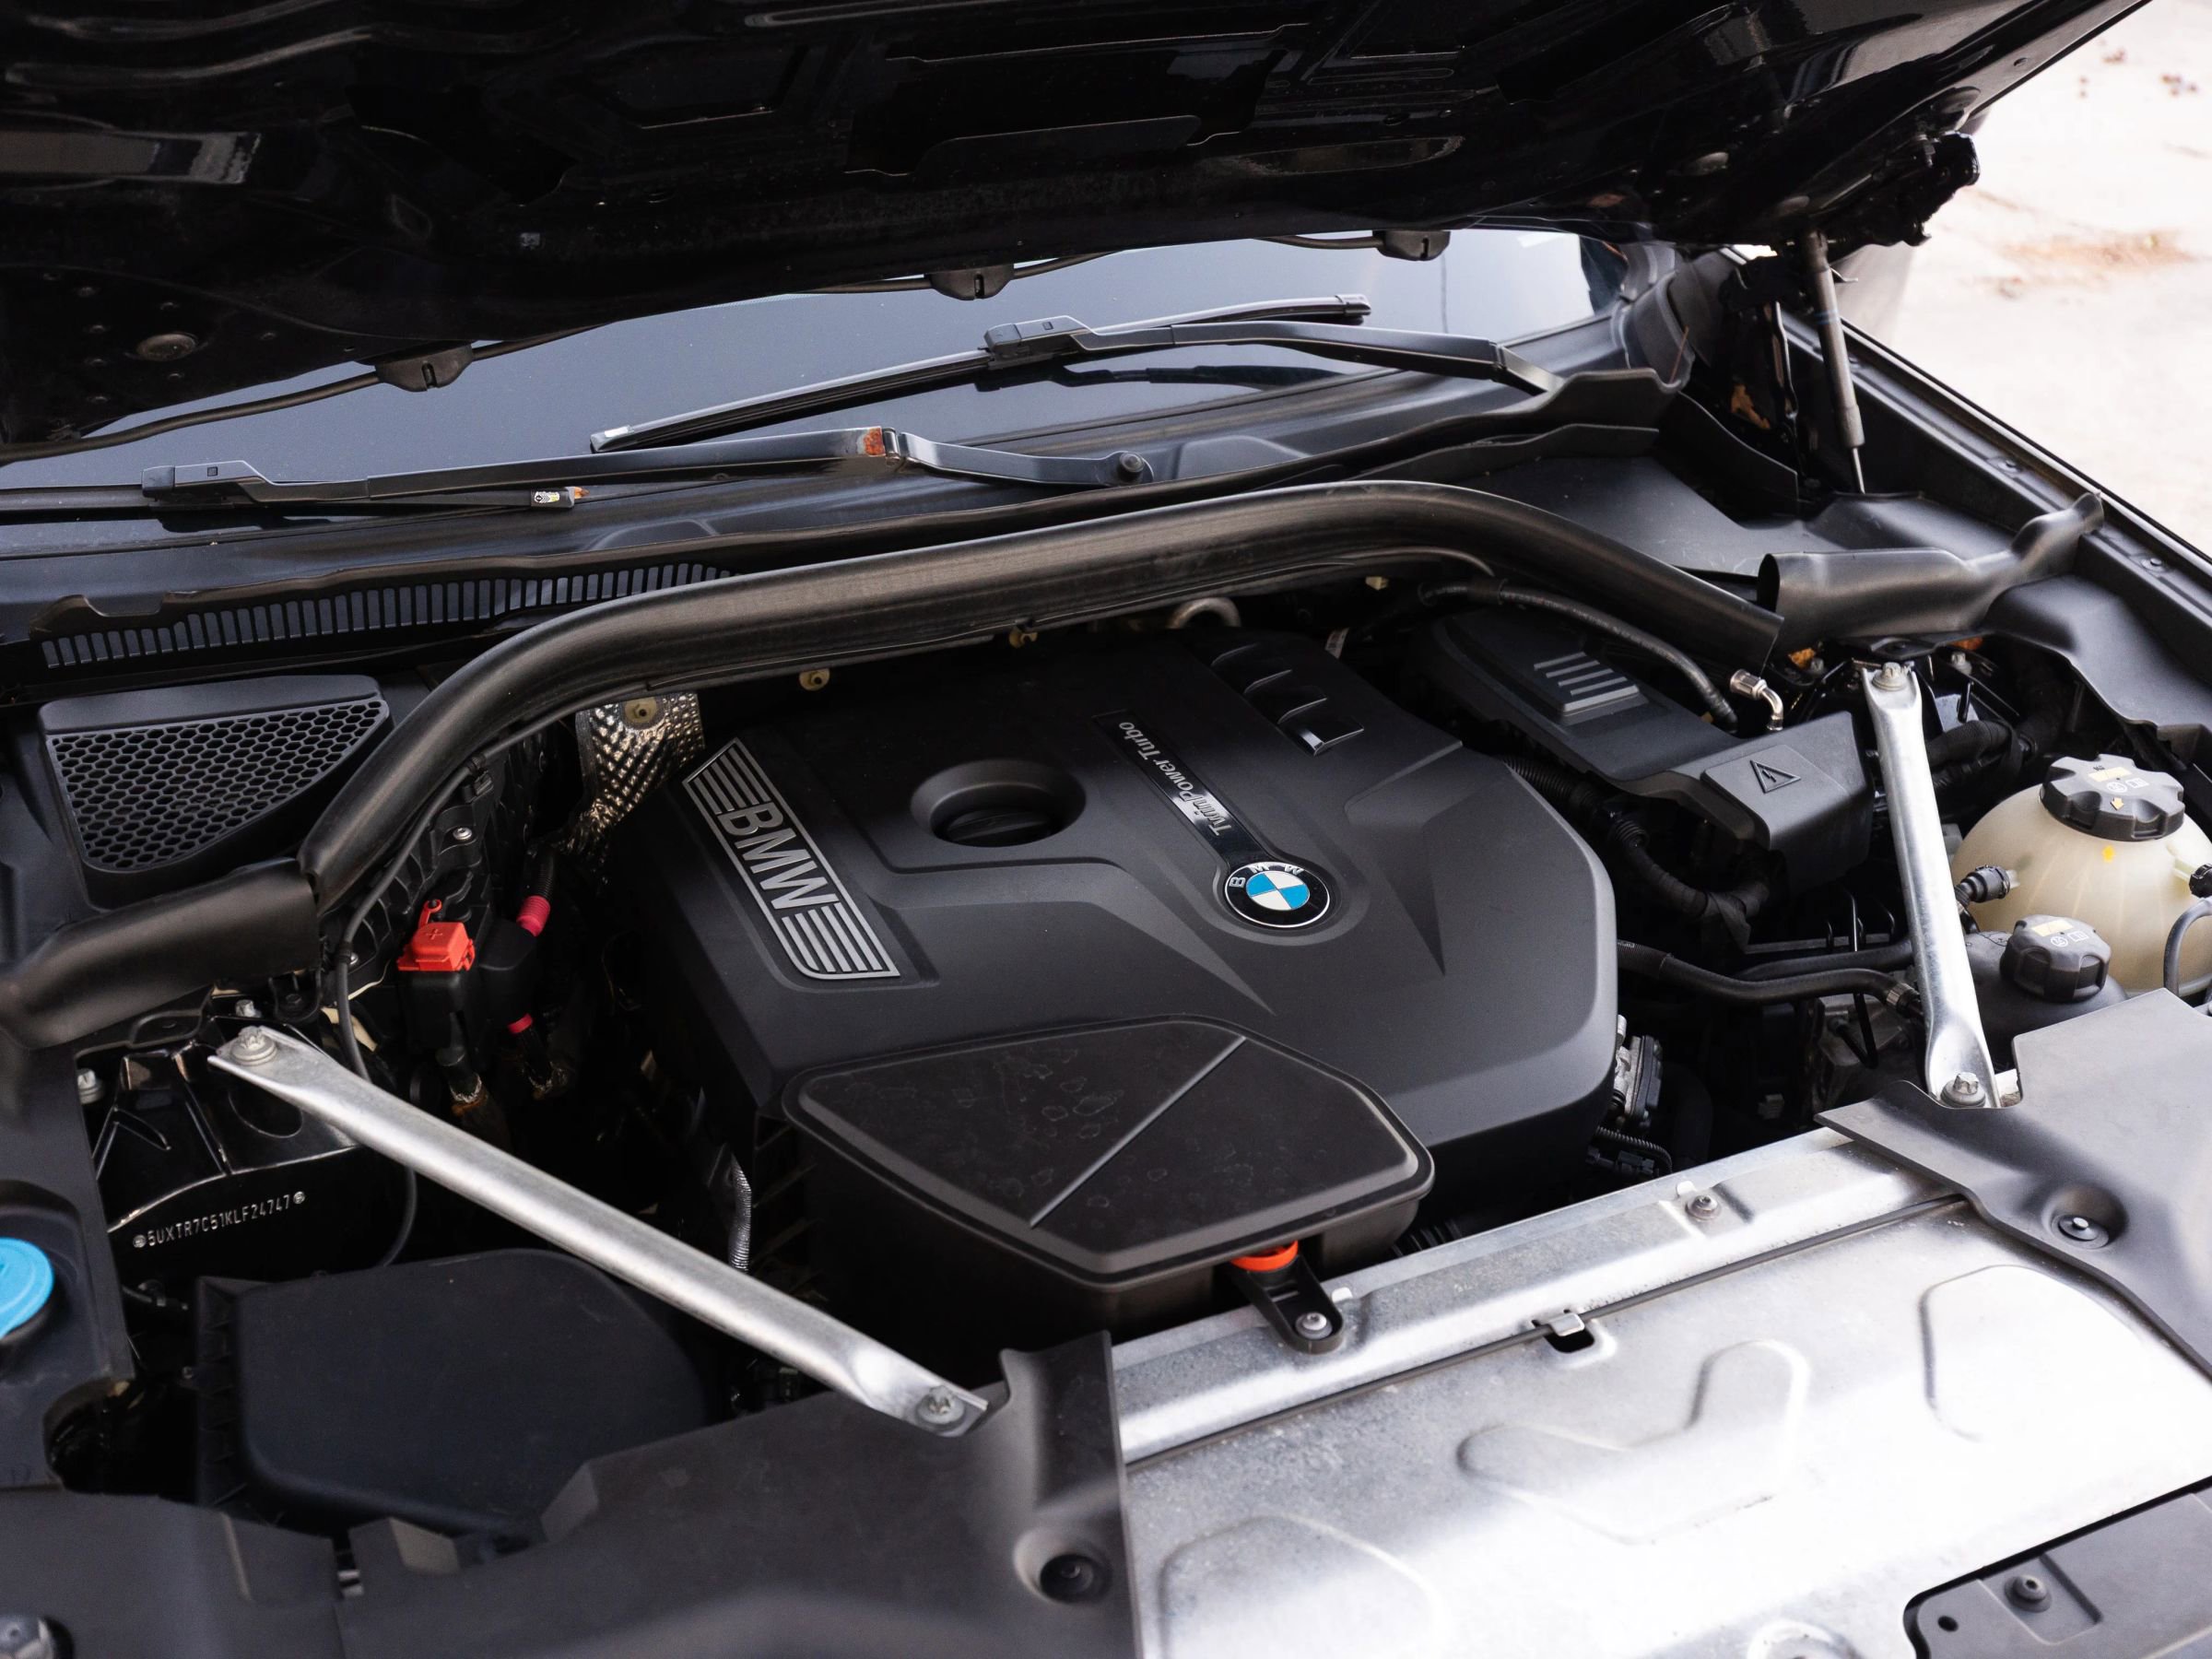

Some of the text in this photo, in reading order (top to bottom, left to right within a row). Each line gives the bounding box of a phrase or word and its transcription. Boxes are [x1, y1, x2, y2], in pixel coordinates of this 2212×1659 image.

[1119, 723, 1231, 835] TwinPower Turbo
[717, 802, 840, 910] BMW
